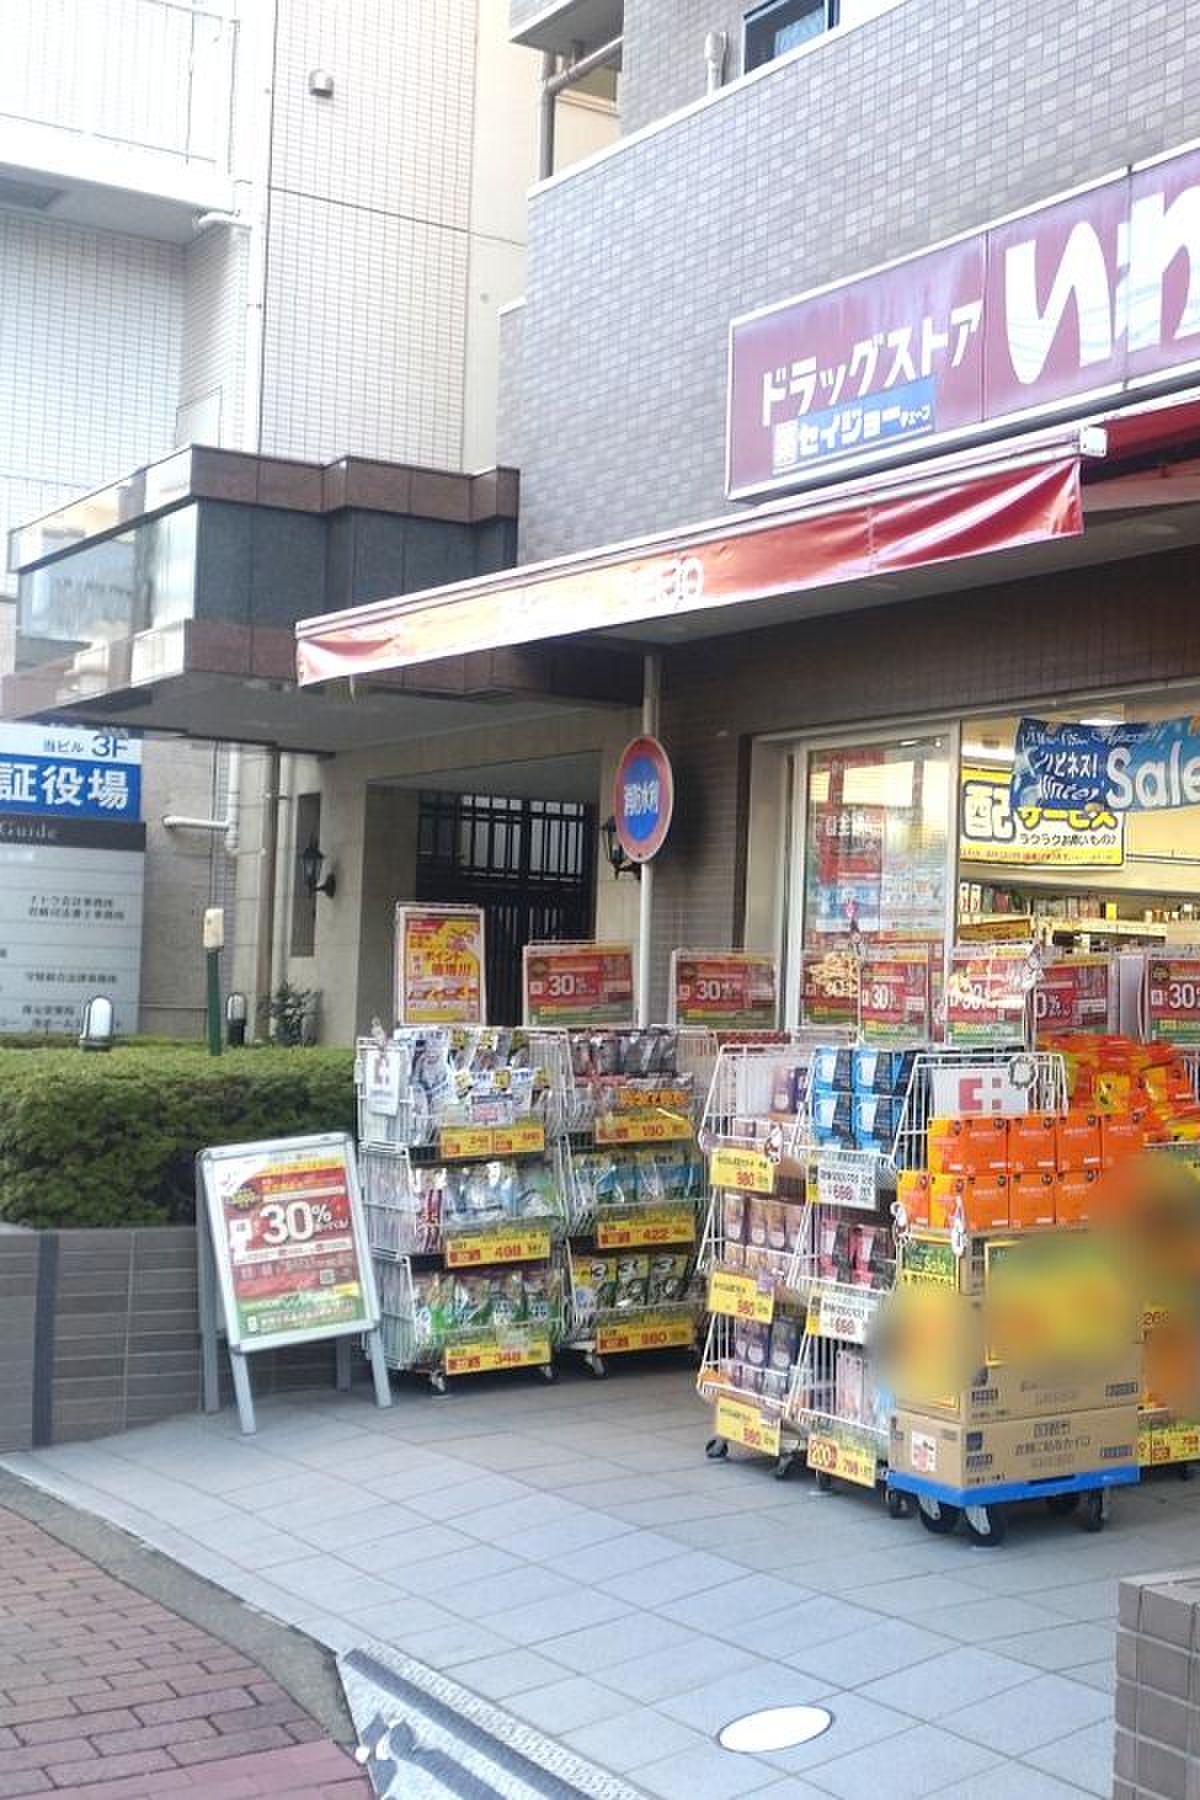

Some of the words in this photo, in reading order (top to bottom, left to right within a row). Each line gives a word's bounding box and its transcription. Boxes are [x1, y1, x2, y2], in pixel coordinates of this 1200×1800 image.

[762, 301, 983, 427] ドラッグストア
[92, 735, 129, 758] 3F
[0, 762, 129, 810] 証役場
